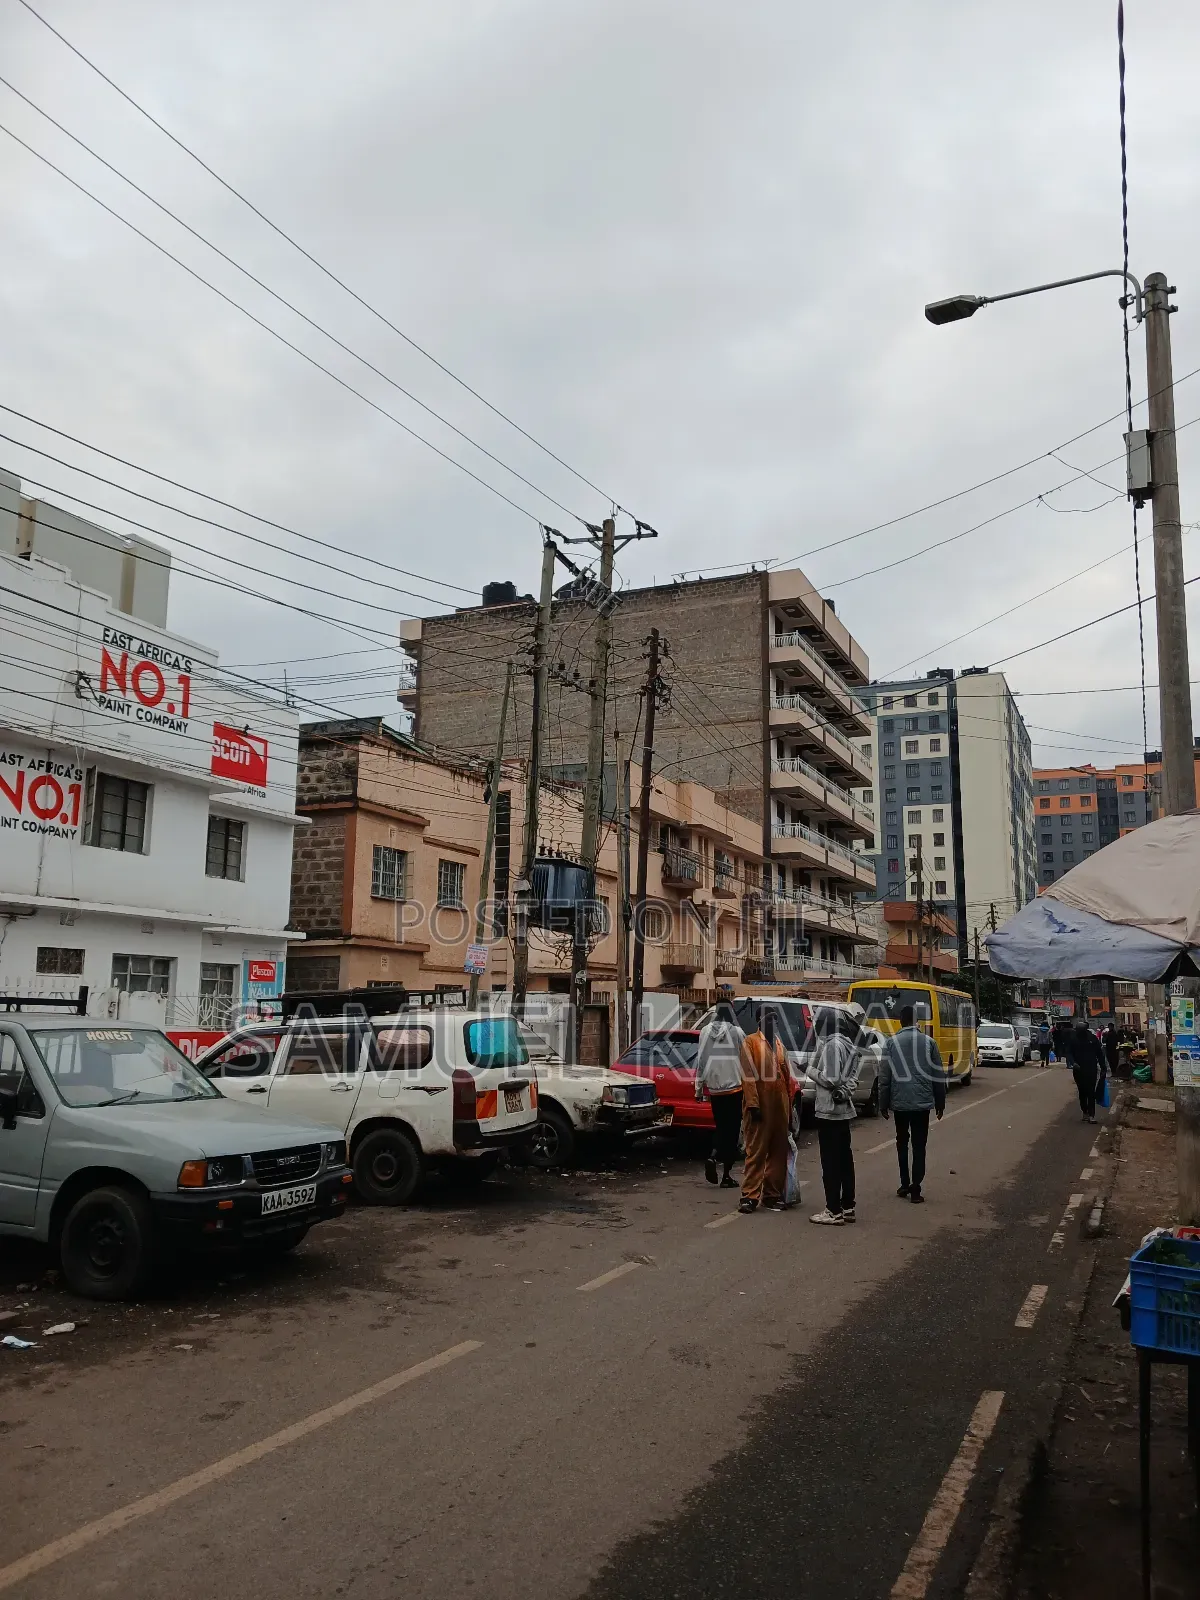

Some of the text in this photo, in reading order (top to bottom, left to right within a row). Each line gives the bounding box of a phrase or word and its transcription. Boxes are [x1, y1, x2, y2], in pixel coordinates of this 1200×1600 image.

[102, 627, 193, 674] EAST AFRICA'S
[99, 644, 191, 719] NO.1
[98, 694, 189, 734] PAINT COMPANY
[27, 758, 83, 782] AFRICA'S
[246, 785, 267, 799] Africa
[21, 820, 78, 841] COMPANY
[85, 1031, 134, 1041] HONEST
[276, 1155, 301, 1166] ISUZU
[262, 1187, 315, 1213] KAA 359Z
